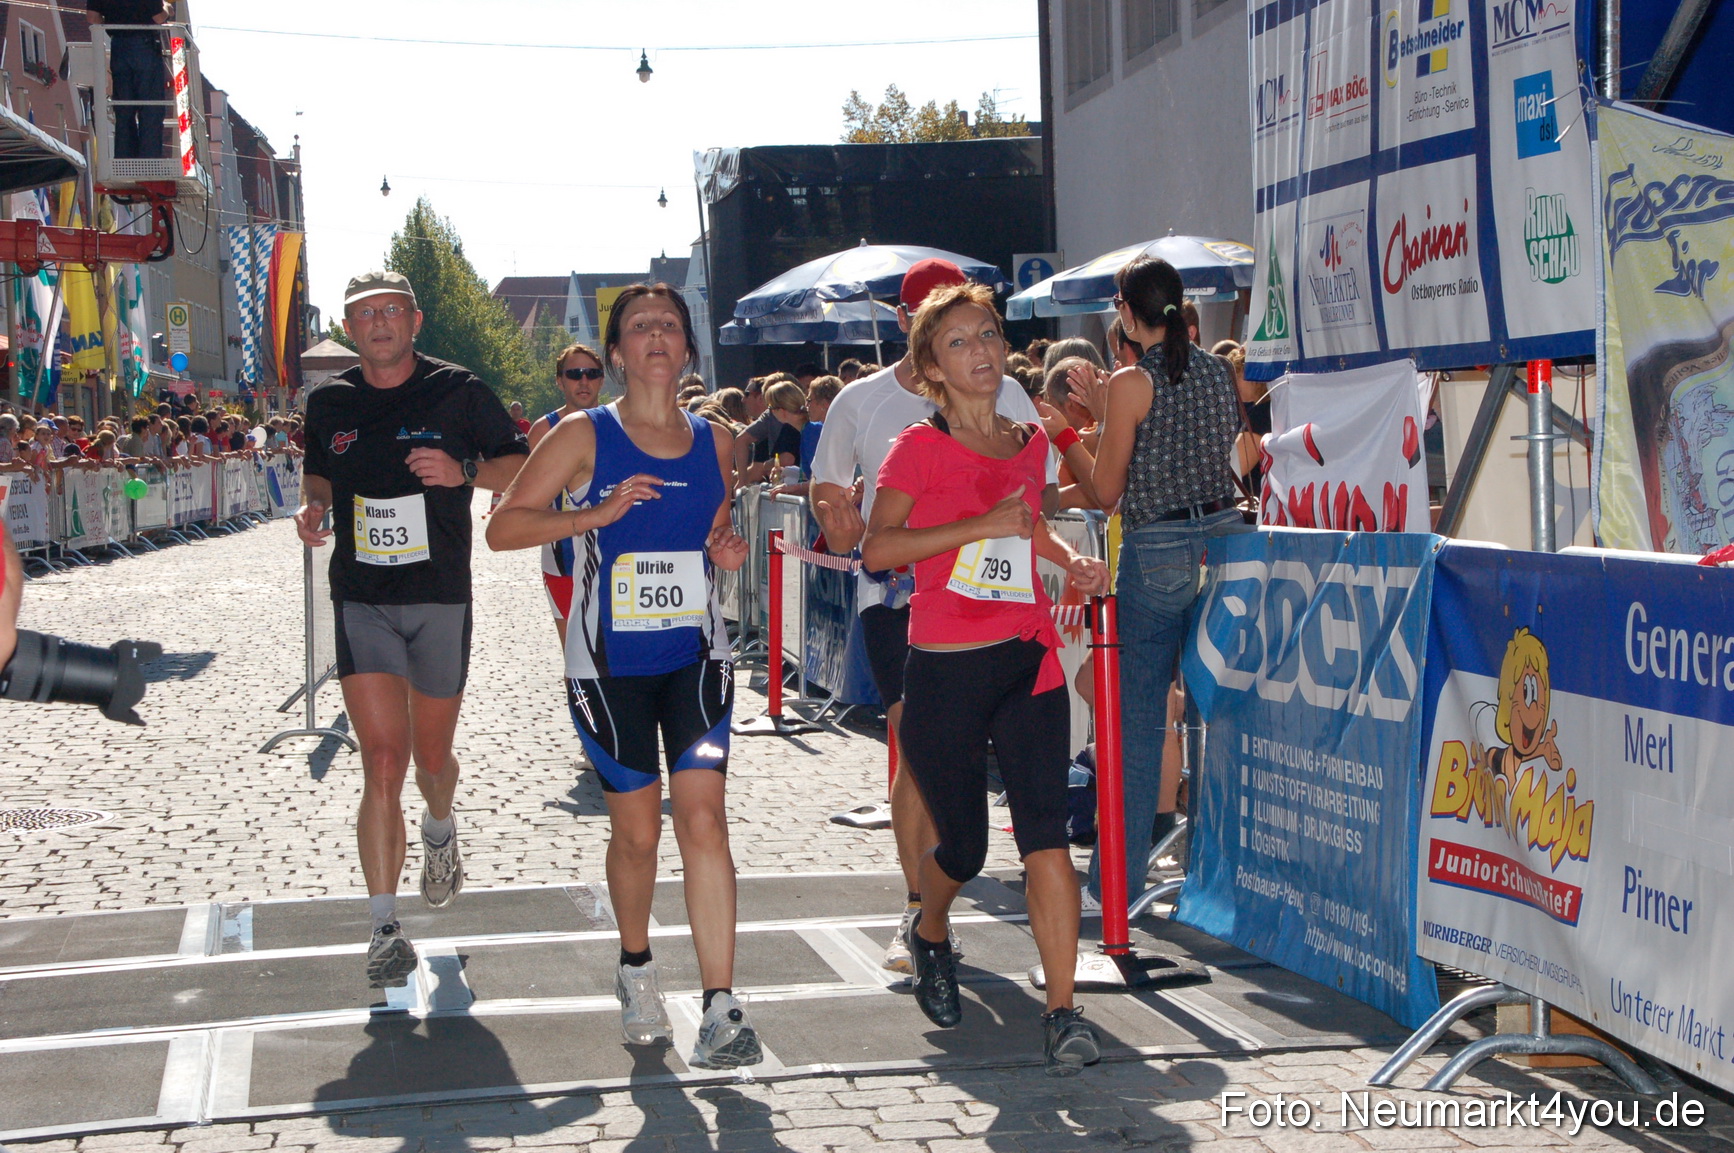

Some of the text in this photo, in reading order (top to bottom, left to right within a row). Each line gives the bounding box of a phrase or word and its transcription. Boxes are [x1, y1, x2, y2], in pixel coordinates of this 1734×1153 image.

[1493, 0, 1543, 43] MCM
[1346, 74, 1368, 101] BÖGL
[1517, 83, 1546, 123] maxi
[1540, 115, 1554, 141] dsl
[1525, 187, 1567, 240] RUND
[1384, 198, 1468, 294] Charivari
[1529, 234, 1581, 282] SCHAU
[1411, 278, 1478, 301] Ostbayerns Radio
[357, 520, 362, 531] D
[365, 505, 396, 518] Klaus
[369, 527, 409, 547] 653
[618, 582, 628, 594] D
[636, 561, 674, 574] Ulrike
[981, 557, 1011, 581] 799
[639, 585, 684, 608] 560
[1625, 601, 1734, 691] Genera
[1253, 736, 1314, 772] ENTWICKLUNG
[1322, 754, 1383, 790] FORMENBAU
[1624, 714, 1673, 773] Merl
[1253, 768, 1380, 825] KUNSTSTOFFVERARBEITUNG
[1253, 799, 1297, 834] ALUMINIUM
[1304, 815, 1362, 854] DRUCKGUSS
[1510, 767, 1594, 873] Maja
[1252, 829, 1290, 863] LOGISTIK
[1236, 865, 1304, 915] Postbauer-Heng
[1622, 865, 1692, 934] Pirner
[1423, 920, 1492, 955] NÜRNBERGER
[1610, 978, 1674, 1035] Unterer
[1677, 1004, 1725, 1060] Markt
